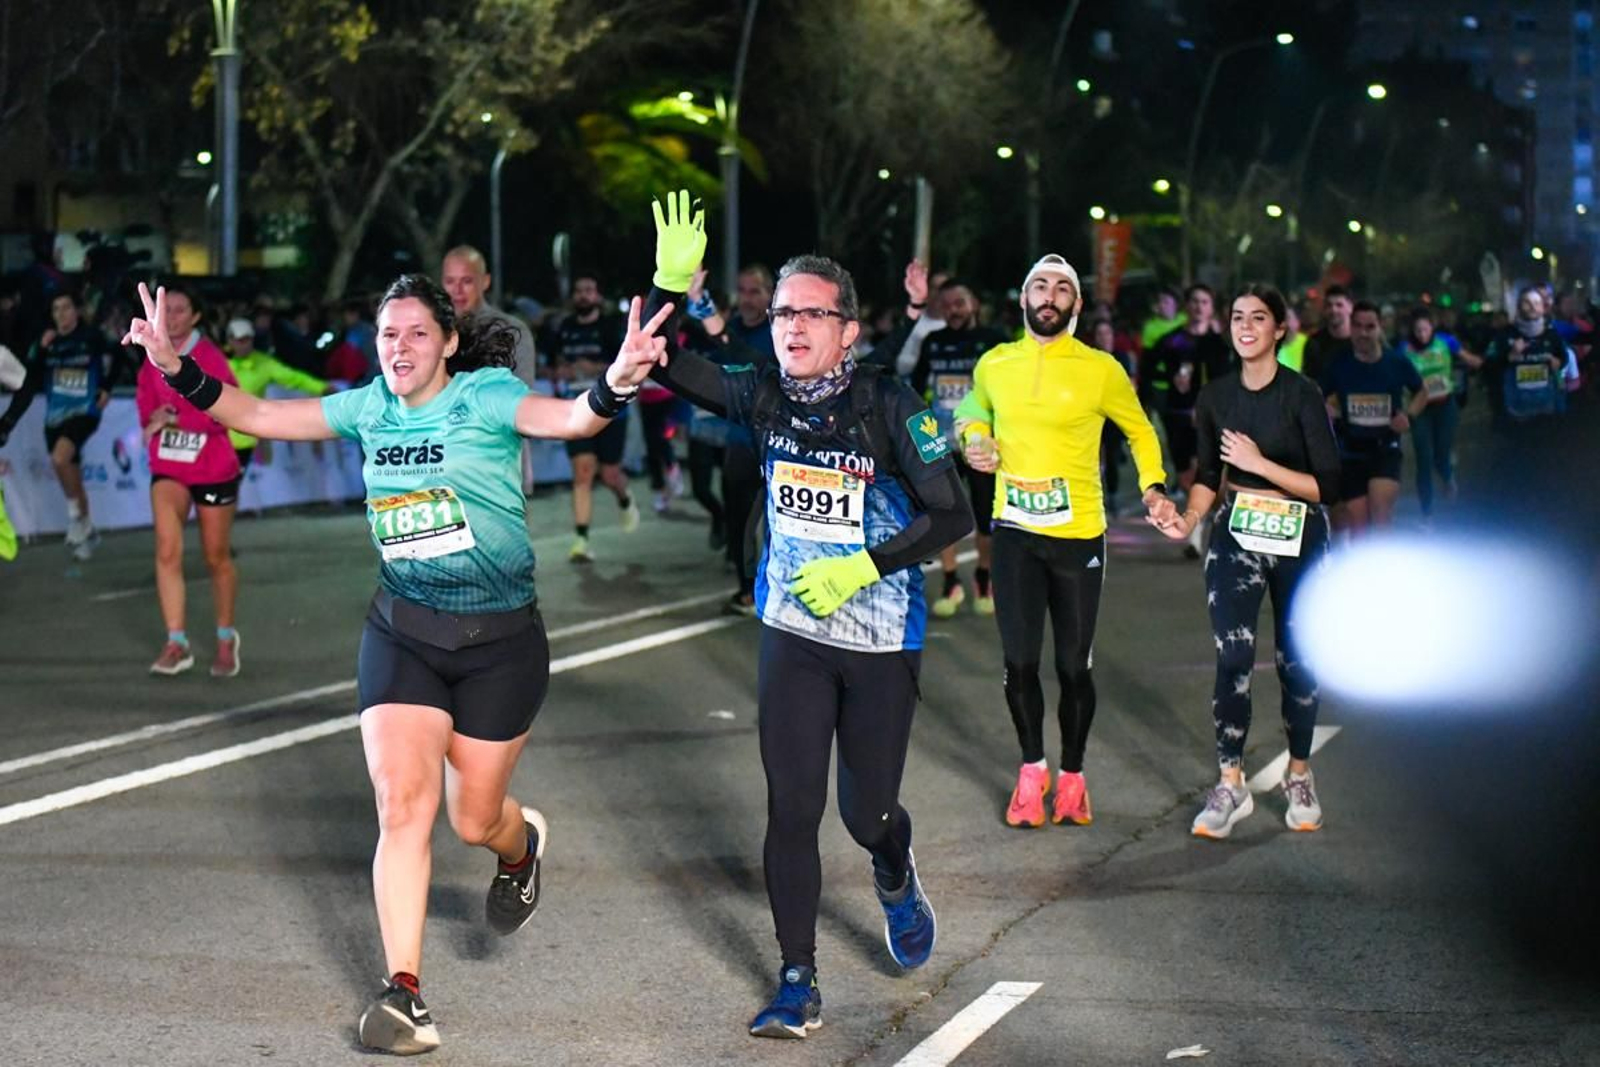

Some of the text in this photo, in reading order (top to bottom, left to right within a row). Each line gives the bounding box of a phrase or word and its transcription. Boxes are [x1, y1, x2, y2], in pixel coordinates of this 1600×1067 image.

[374, 438, 444, 466] serás
[779, 485, 850, 518] 8991
[1007, 487, 1064, 510] 1103
[381, 500, 453, 537] 1831
[1239, 510, 1297, 536] 1265
